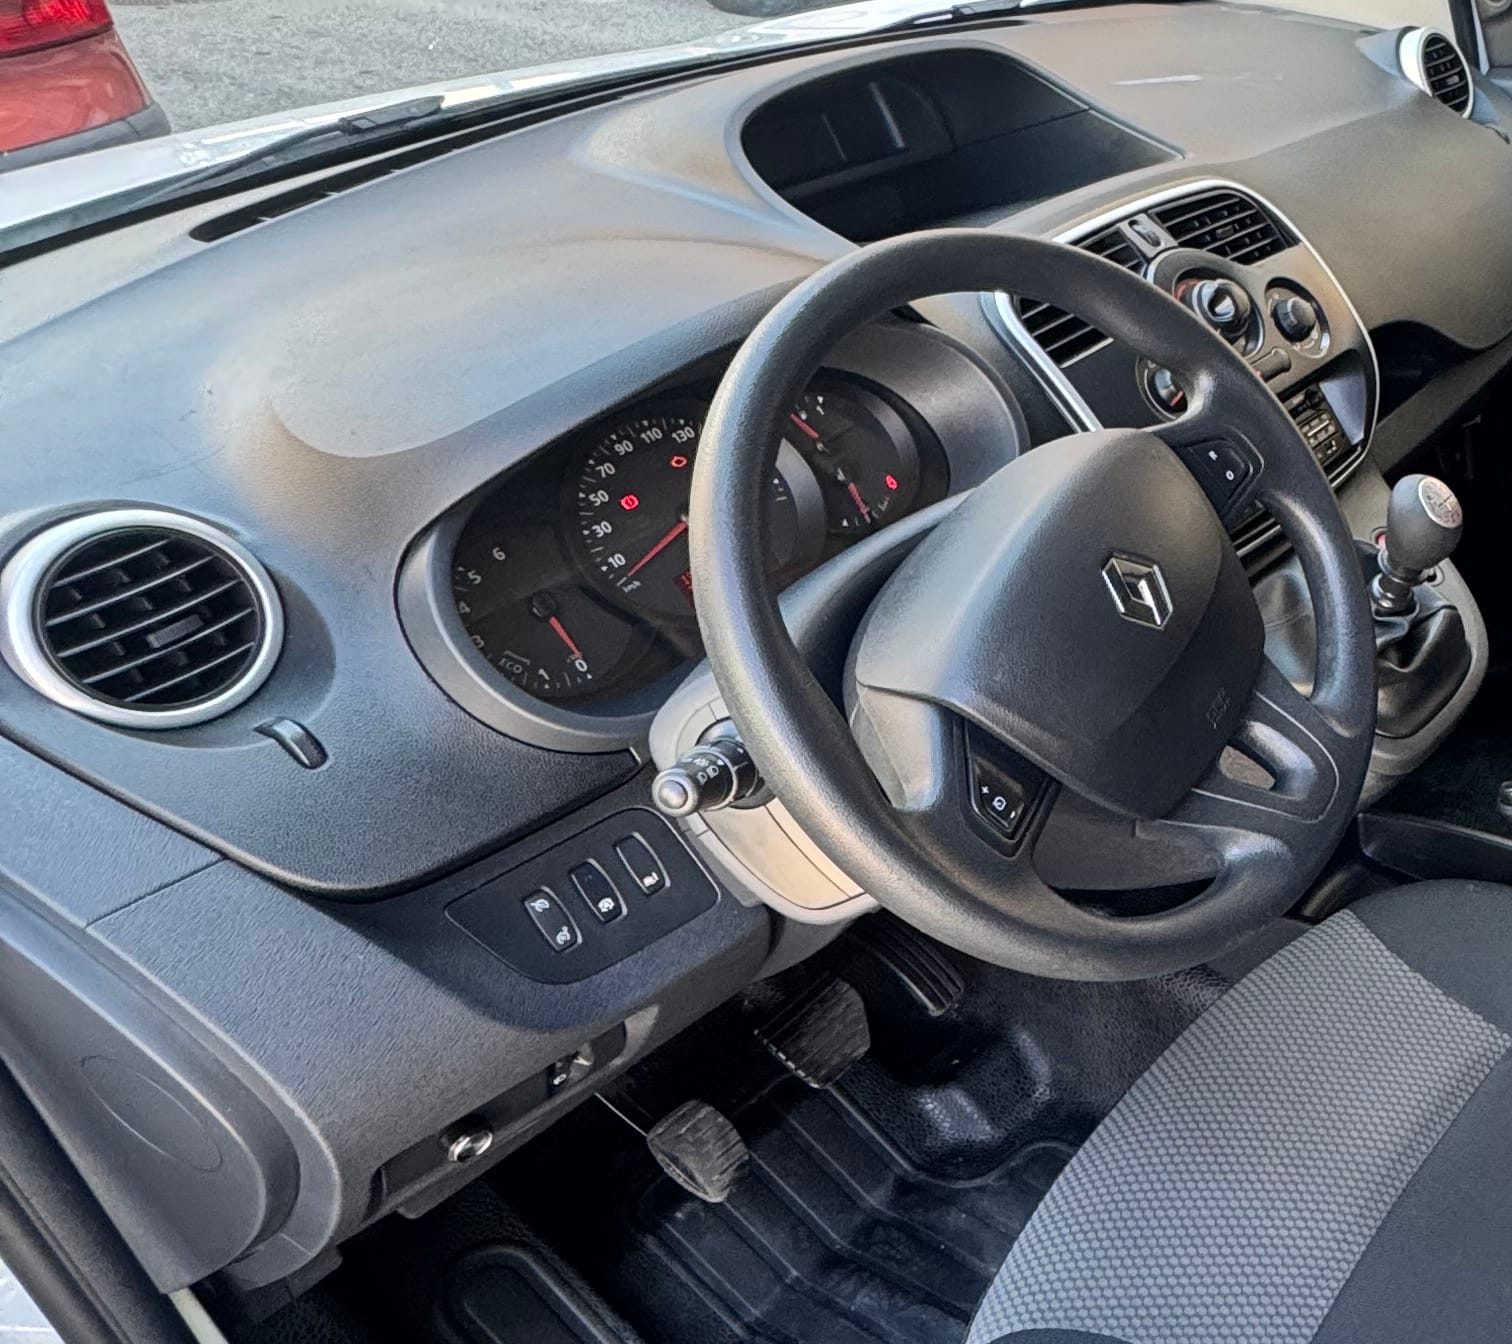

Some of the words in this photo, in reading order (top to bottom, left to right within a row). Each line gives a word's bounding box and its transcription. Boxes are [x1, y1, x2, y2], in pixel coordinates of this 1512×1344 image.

[640, 427, 663, 444] 110
[671, 427, 696, 444] 130
[614, 440, 634, 456] 90
[595, 462, 616, 478] 70
[588, 490, 609, 506] 50
[591, 521, 613, 538] 30
[492, 547, 506, 561] 6
[607, 553, 626, 569] 10
[467, 570, 482, 585] 5
[458, 600, 471, 615] 4
[498, 657, 524, 674] ECO
[574, 659, 588, 673] 0
[538, 668, 551, 681] 1
